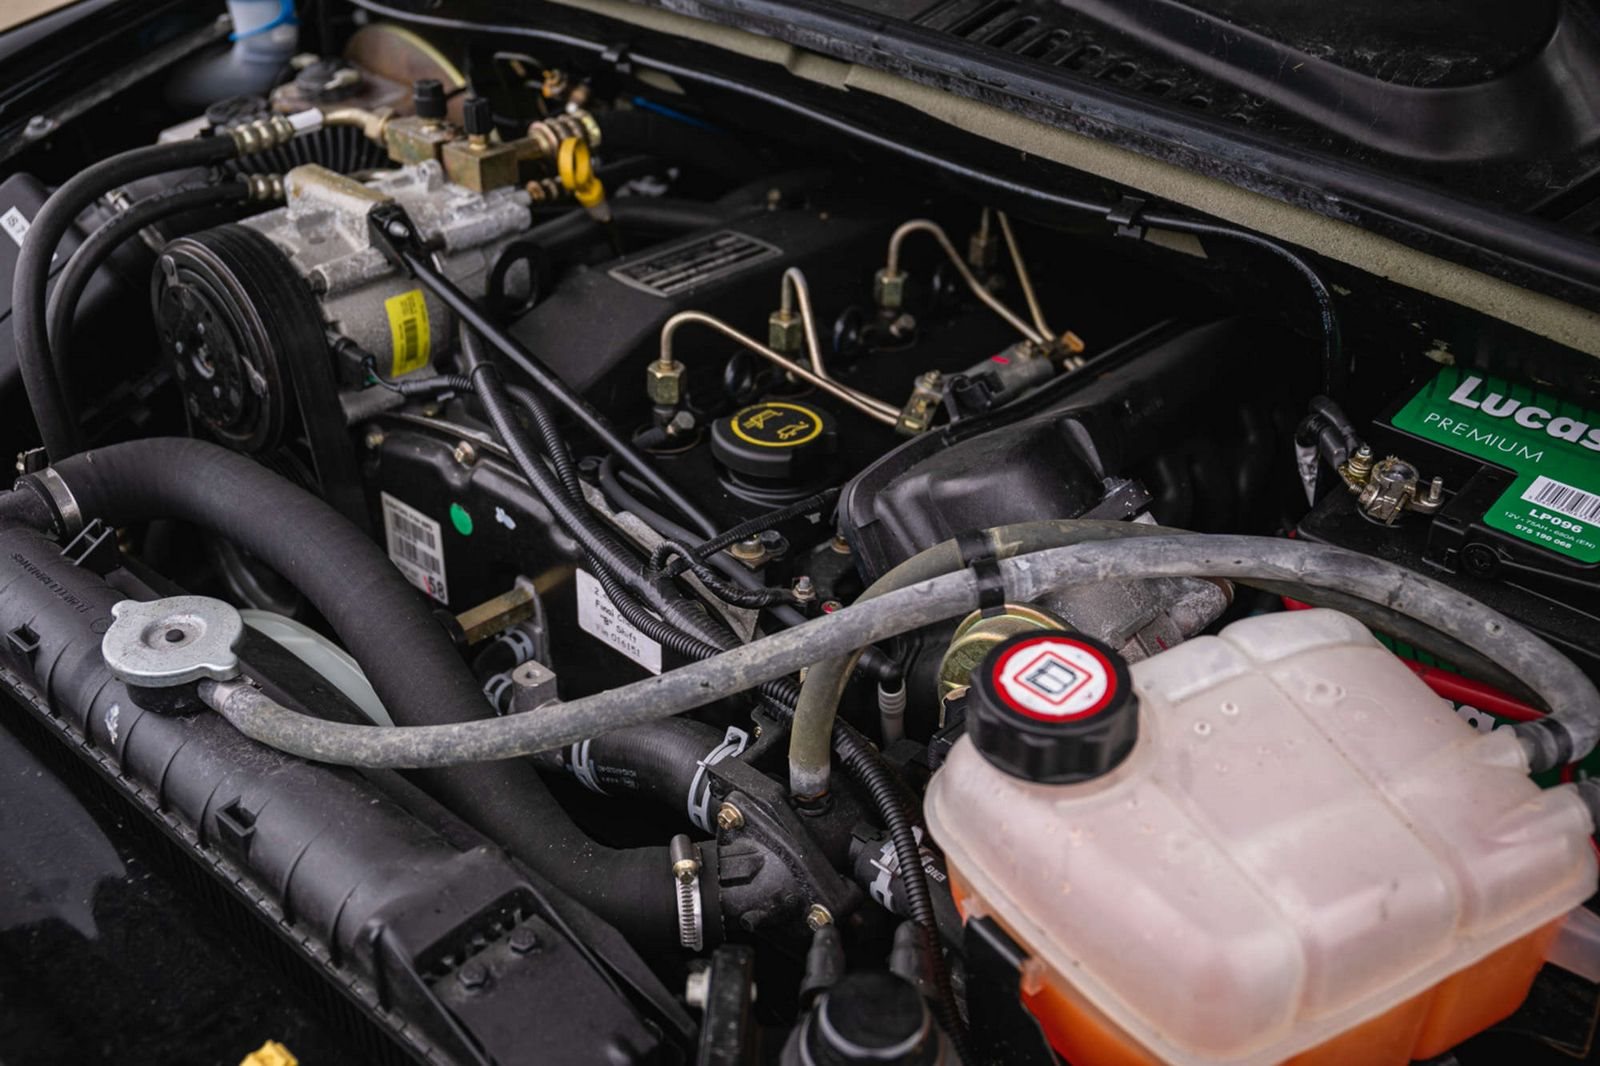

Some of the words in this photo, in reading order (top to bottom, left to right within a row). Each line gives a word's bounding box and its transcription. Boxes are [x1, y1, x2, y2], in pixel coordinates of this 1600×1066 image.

[1424, 412, 1544, 463] PREMIUM
[1448, 375, 1600, 451] Lucas
[1528, 509, 1583, 533] LP096
